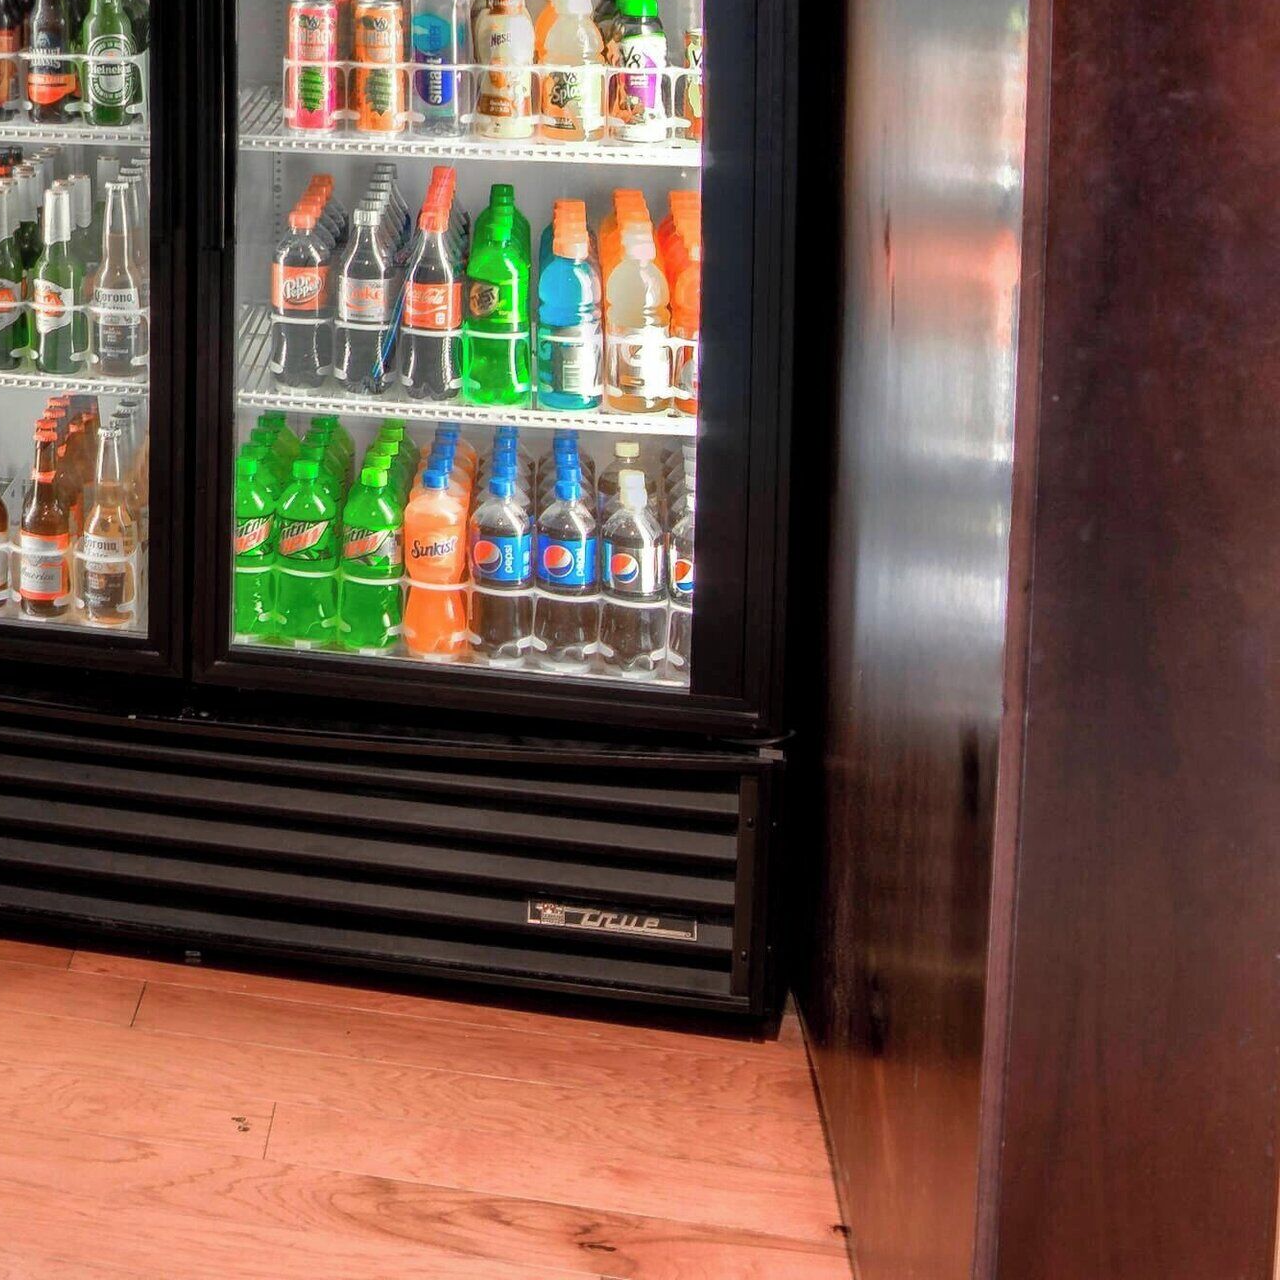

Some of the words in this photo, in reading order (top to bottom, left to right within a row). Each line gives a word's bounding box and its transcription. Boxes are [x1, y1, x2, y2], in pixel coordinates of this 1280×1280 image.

[427, 56, 442, 104] smat
[551, 82, 583, 106] Spla
[284, 277, 322, 300] Pepper
[296, 275, 311, 288] Dr
[95, 288, 135, 303] Corona
[411, 536, 458, 559] Sunkist
[504, 544, 513, 575] pepsi
[576, 547, 586, 577] pepsi
